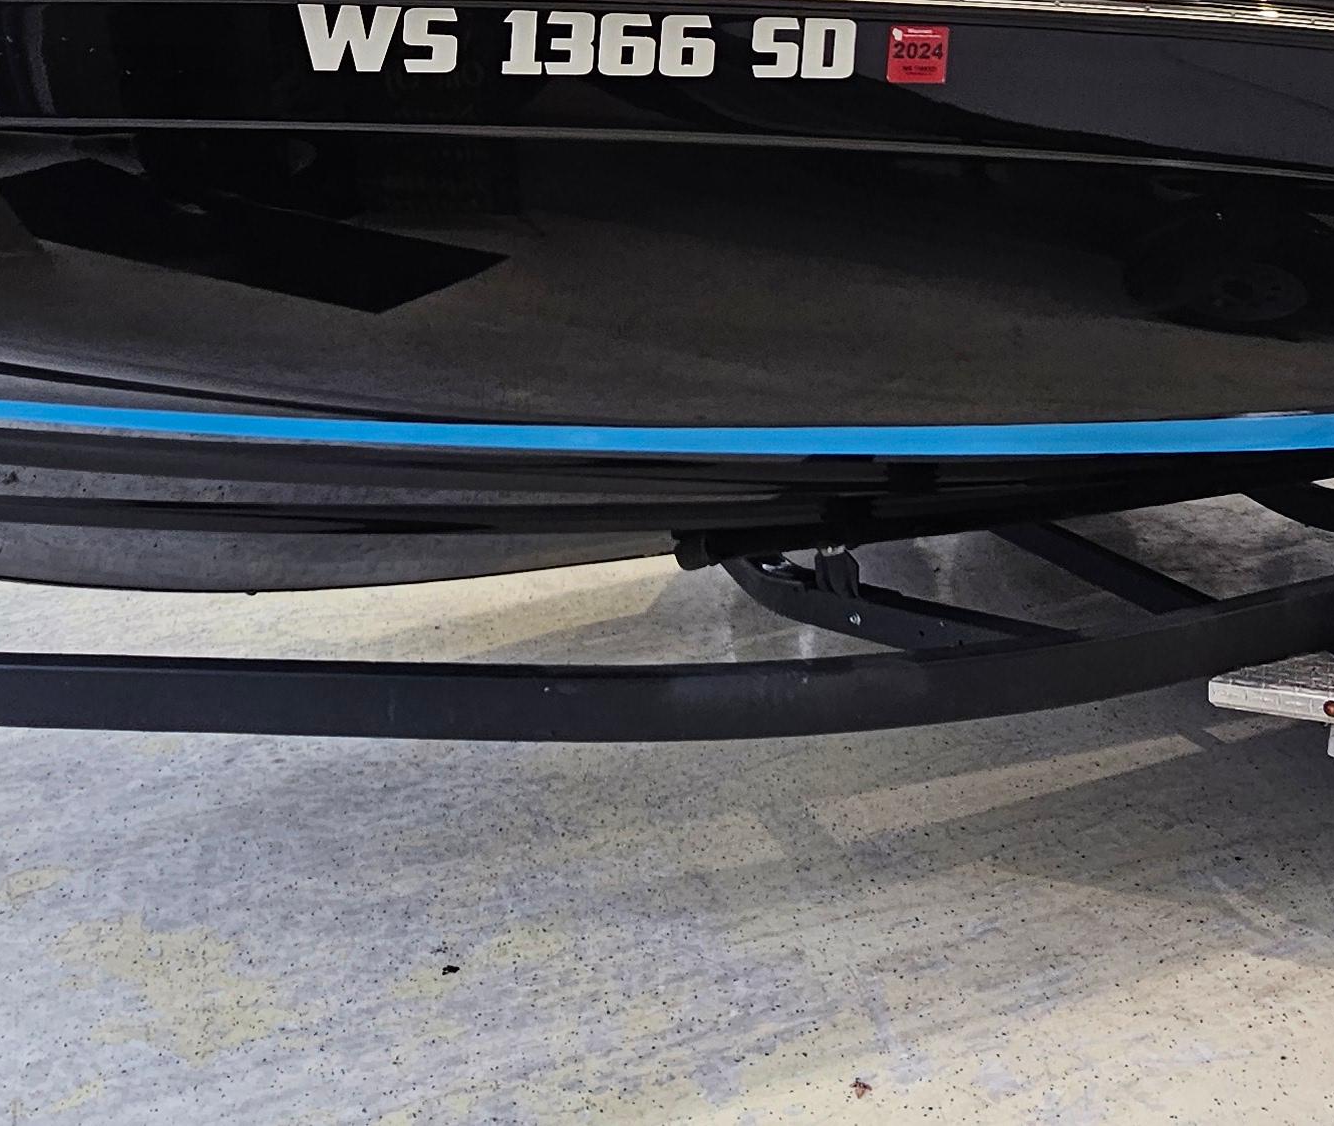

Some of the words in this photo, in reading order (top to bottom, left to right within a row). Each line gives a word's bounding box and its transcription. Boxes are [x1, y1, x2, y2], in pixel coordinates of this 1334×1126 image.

[297, 3, 459, 74] WS
[501, 9, 717, 78] 1366
[752, 16, 858, 80] SD
[892, 41, 944, 61] 2024
